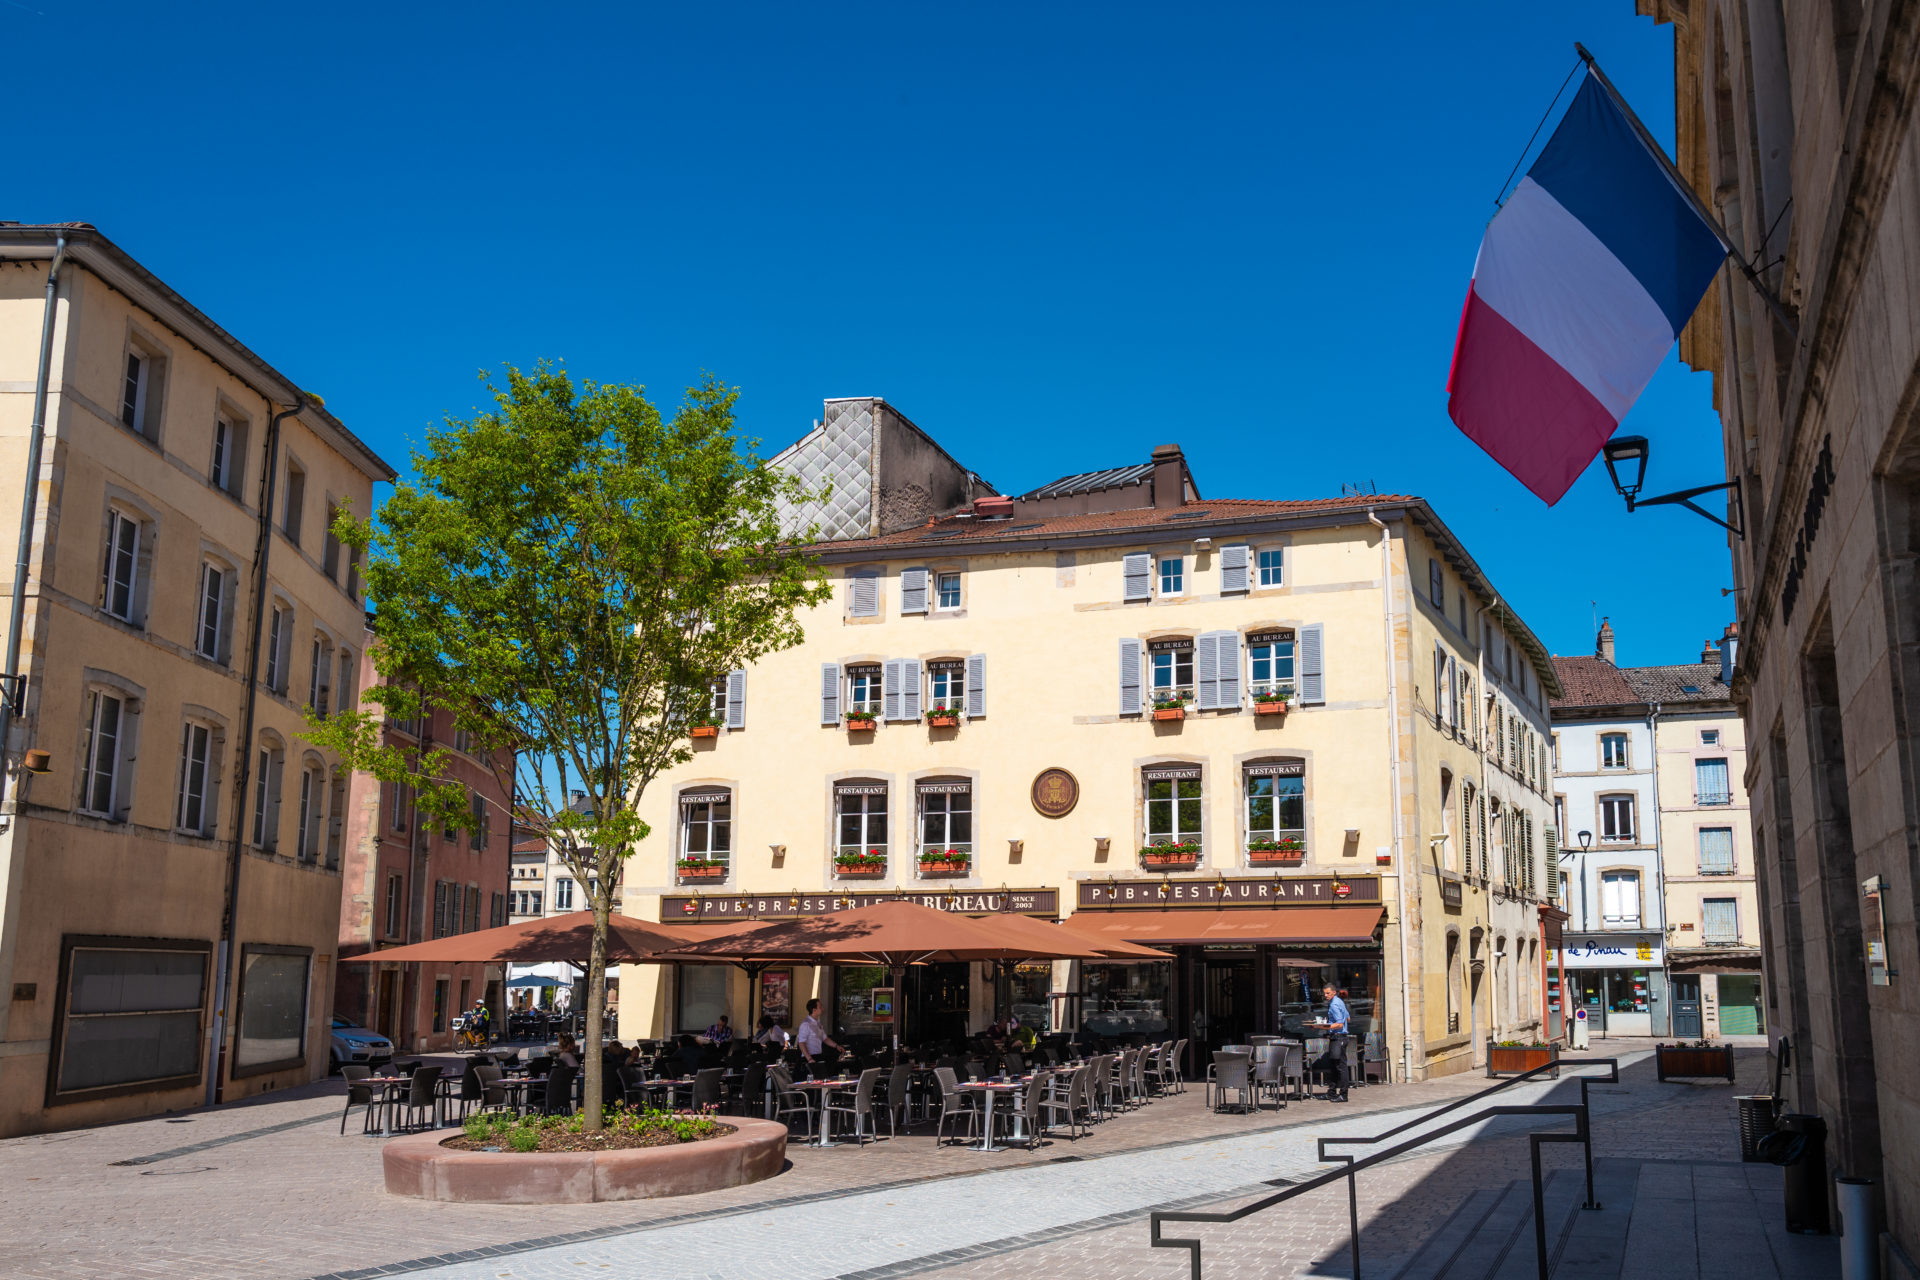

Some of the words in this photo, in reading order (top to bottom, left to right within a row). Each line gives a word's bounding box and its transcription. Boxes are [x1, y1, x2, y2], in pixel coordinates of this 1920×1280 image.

[1262, 633, 1293, 641] BUREAU
[1163, 641, 1192, 649] BUREAU
[1249, 766, 1301, 775] RESTAURANT
[1147, 771, 1198, 779] RESTAURANT
[838, 787, 884, 795] RESTAURANT
[920, 786, 968, 794] RESTAURANT
[681, 795, 725, 804] RESTAURANT
[1092, 886, 1135, 900] PUB
[1157, 884, 1321, 898] RESTAURANT
[704, 900, 744, 912] PUB
[922, 895, 1001, 911] BUREAU
[1567, 942, 1581, 956] de
